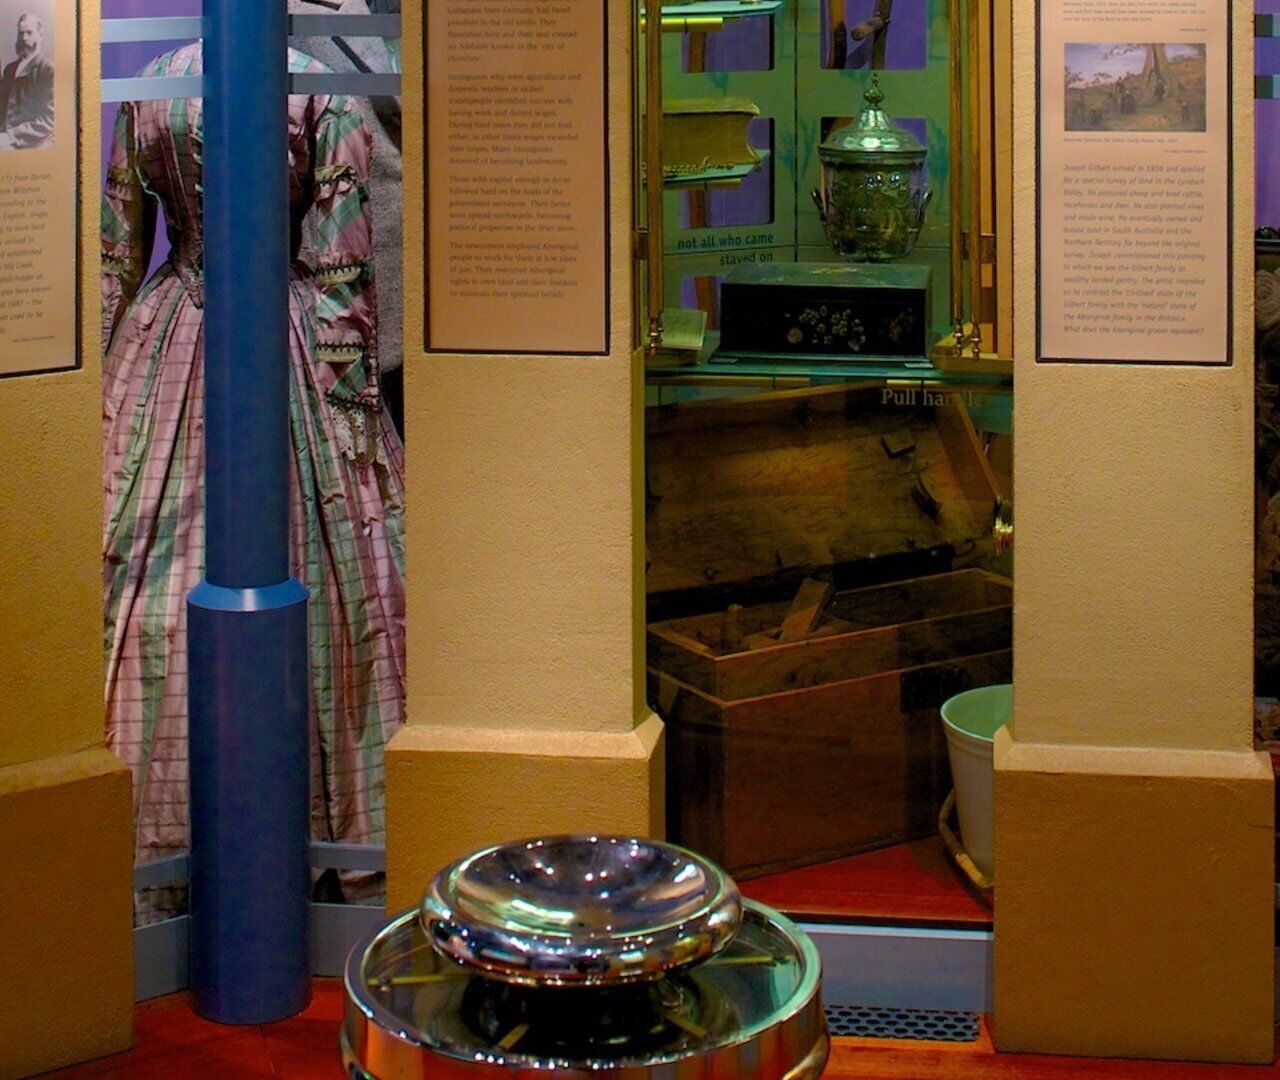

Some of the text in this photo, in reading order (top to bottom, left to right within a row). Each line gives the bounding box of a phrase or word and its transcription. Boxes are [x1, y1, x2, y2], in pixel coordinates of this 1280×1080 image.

[677, 233, 774, 250] not all who came
[759, 252, 774, 263] on
[881, 388, 917, 406] Pull
